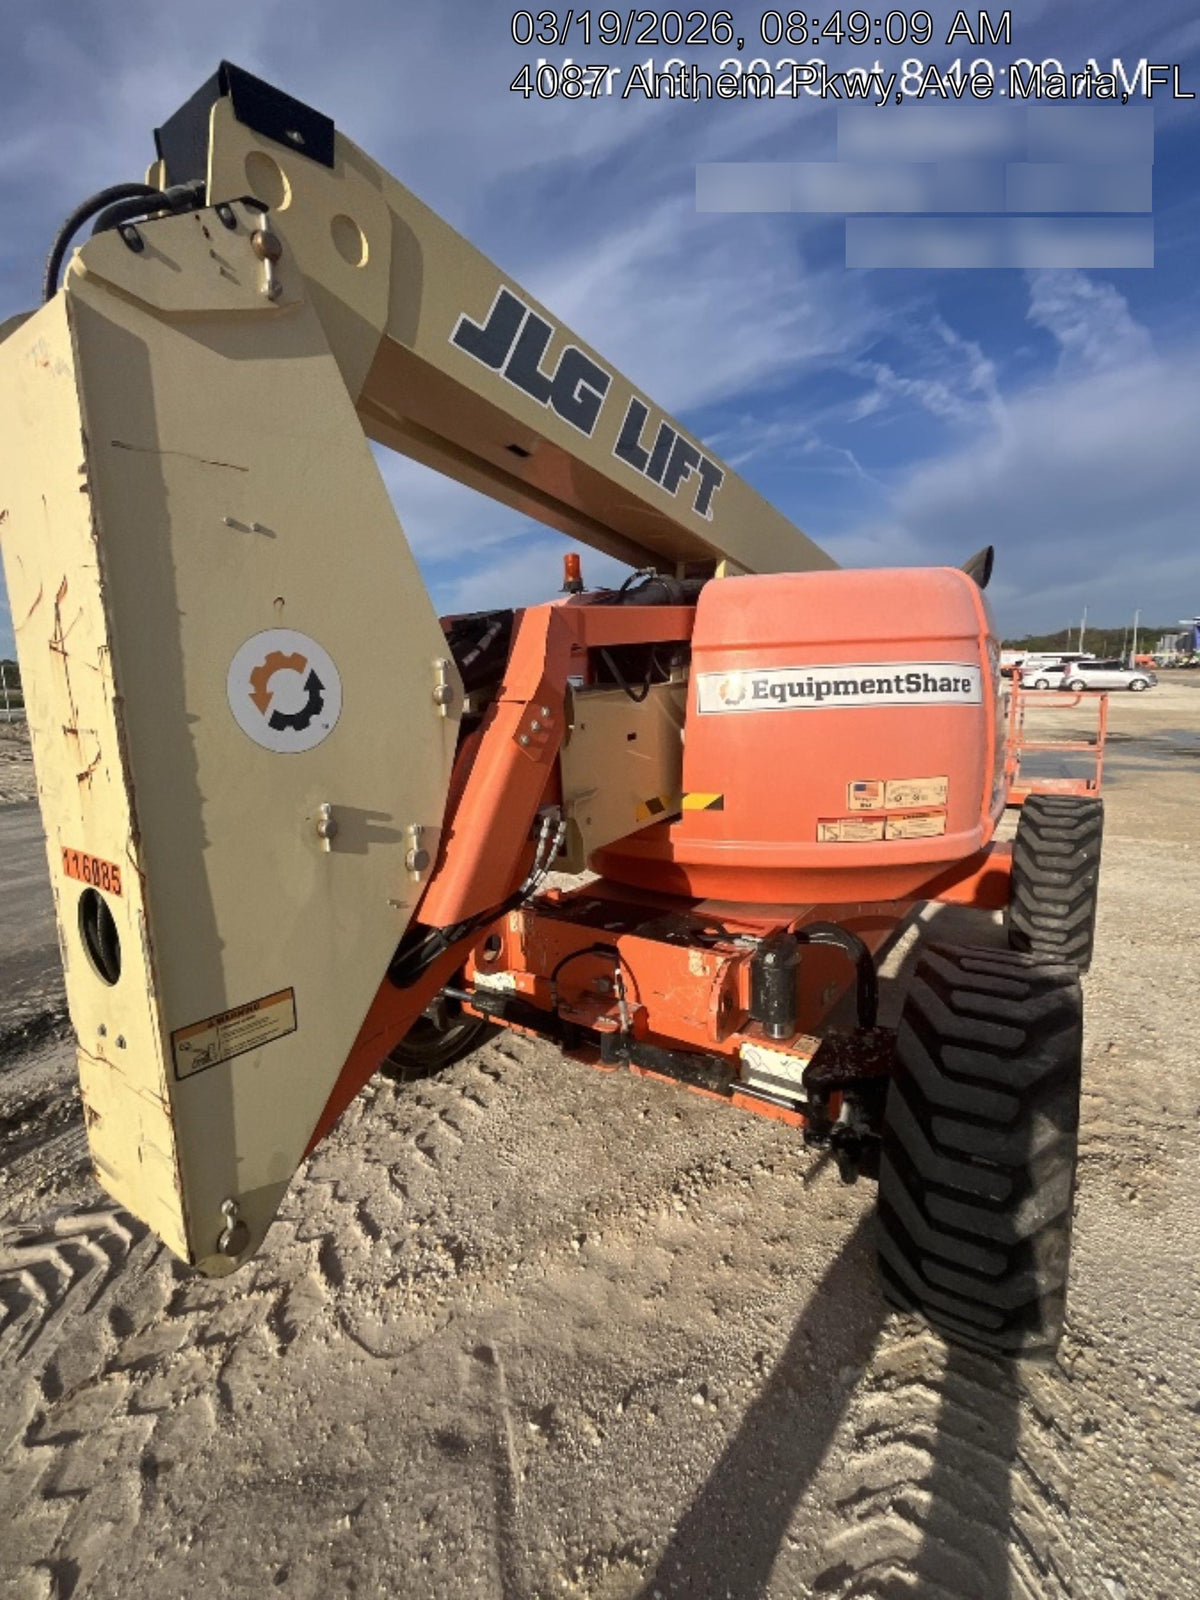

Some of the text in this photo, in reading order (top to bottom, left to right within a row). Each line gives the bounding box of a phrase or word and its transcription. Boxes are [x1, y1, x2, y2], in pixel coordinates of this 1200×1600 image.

[449, 284, 726, 519] JLG LIFT
[751, 674, 971, 703] EquipmentShare
[63, 849, 122, 895] 116085
